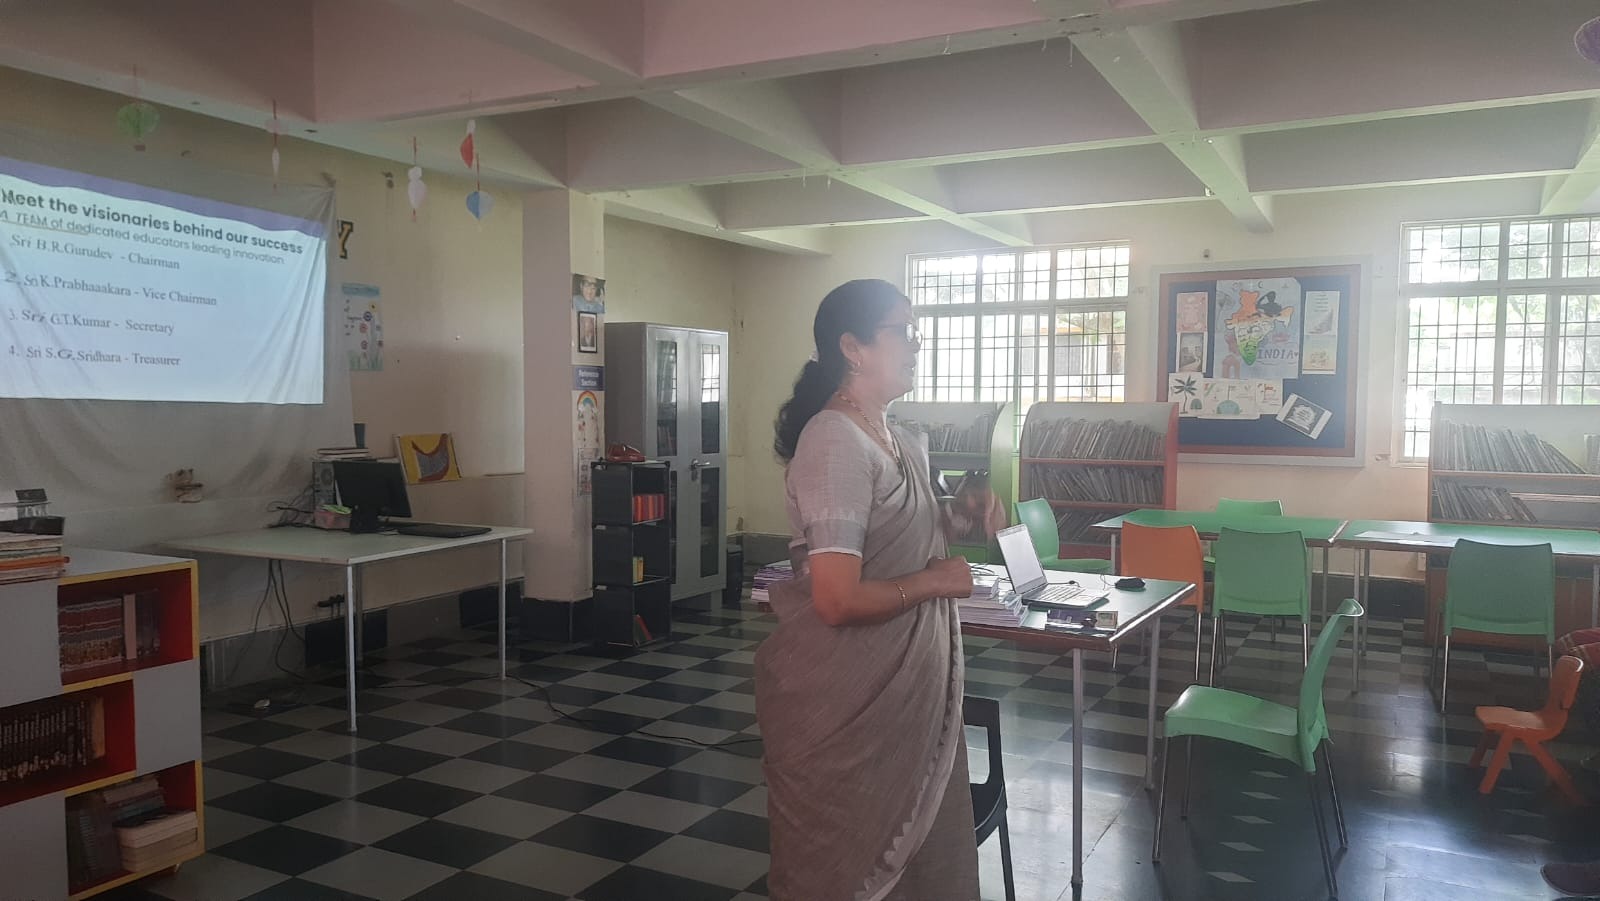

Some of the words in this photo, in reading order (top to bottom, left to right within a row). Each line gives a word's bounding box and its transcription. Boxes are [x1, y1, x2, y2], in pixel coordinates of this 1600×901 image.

[1, 188, 45, 208] Meet
[49, 198, 78, 215] the
[82, 203, 170, 231] visionaries
[173, 220, 223, 240] behind
[226, 231, 249, 245] our
[251, 236, 303, 254] success
[16, 212, 48, 227] TEAM
[51, 218, 63, 229] of
[66, 221, 130, 241] dedicated
[132, 231, 190, 250] educators
[192, 241, 231, 258] leading
[233, 248, 285, 265] innovation
[11, 234, 32, 248] Sri
[128, 252, 180, 270] Chairman
[142, 287, 166, 301] Vice
[168, 291, 217, 306] Chairman
[125, 319, 175, 337] Secretary
[26, 346, 42, 359] Sri
[132, 352, 181, 367] Treasurer
[1257, 348, 1294, 360] INDIA
